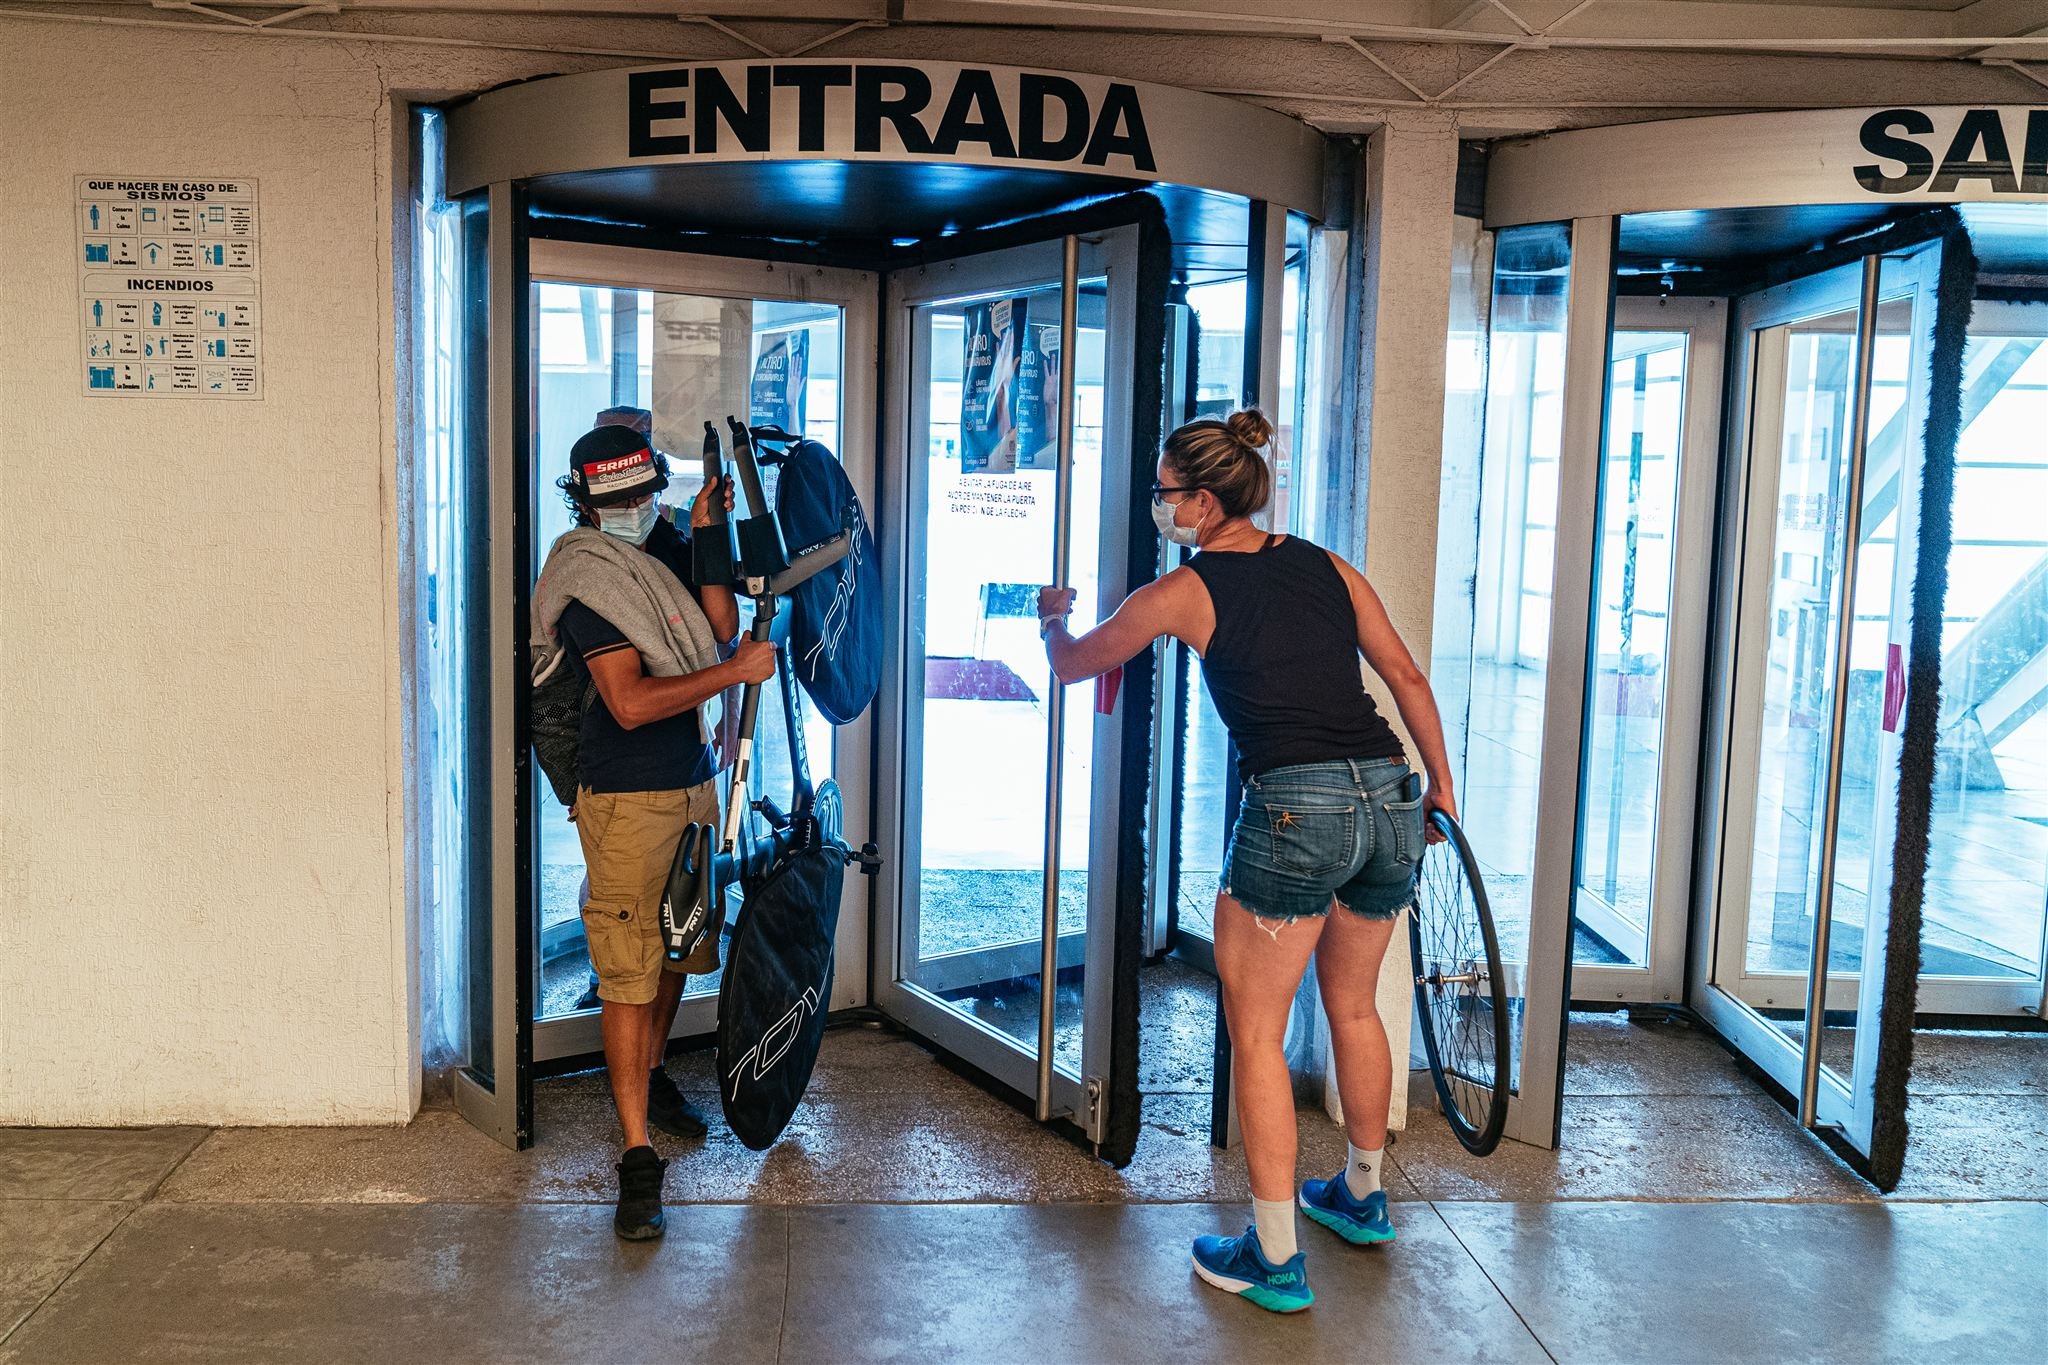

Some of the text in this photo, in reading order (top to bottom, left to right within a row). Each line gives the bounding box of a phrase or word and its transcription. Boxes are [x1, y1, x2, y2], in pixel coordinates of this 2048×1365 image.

[628, 65, 1157, 173] ENTRADA
[88, 181, 238, 193] QUE HACER EN CASO DE:
[127, 191, 206, 201] SISMOS
[127, 279, 214, 292] INCENDIOS
[596, 453, 642, 473] SRAM
[606, 475, 644, 489] RACING TEAM
[1012, 494, 1036, 506] PUERTA
[1267, 1272, 1297, 1285] HOKA
